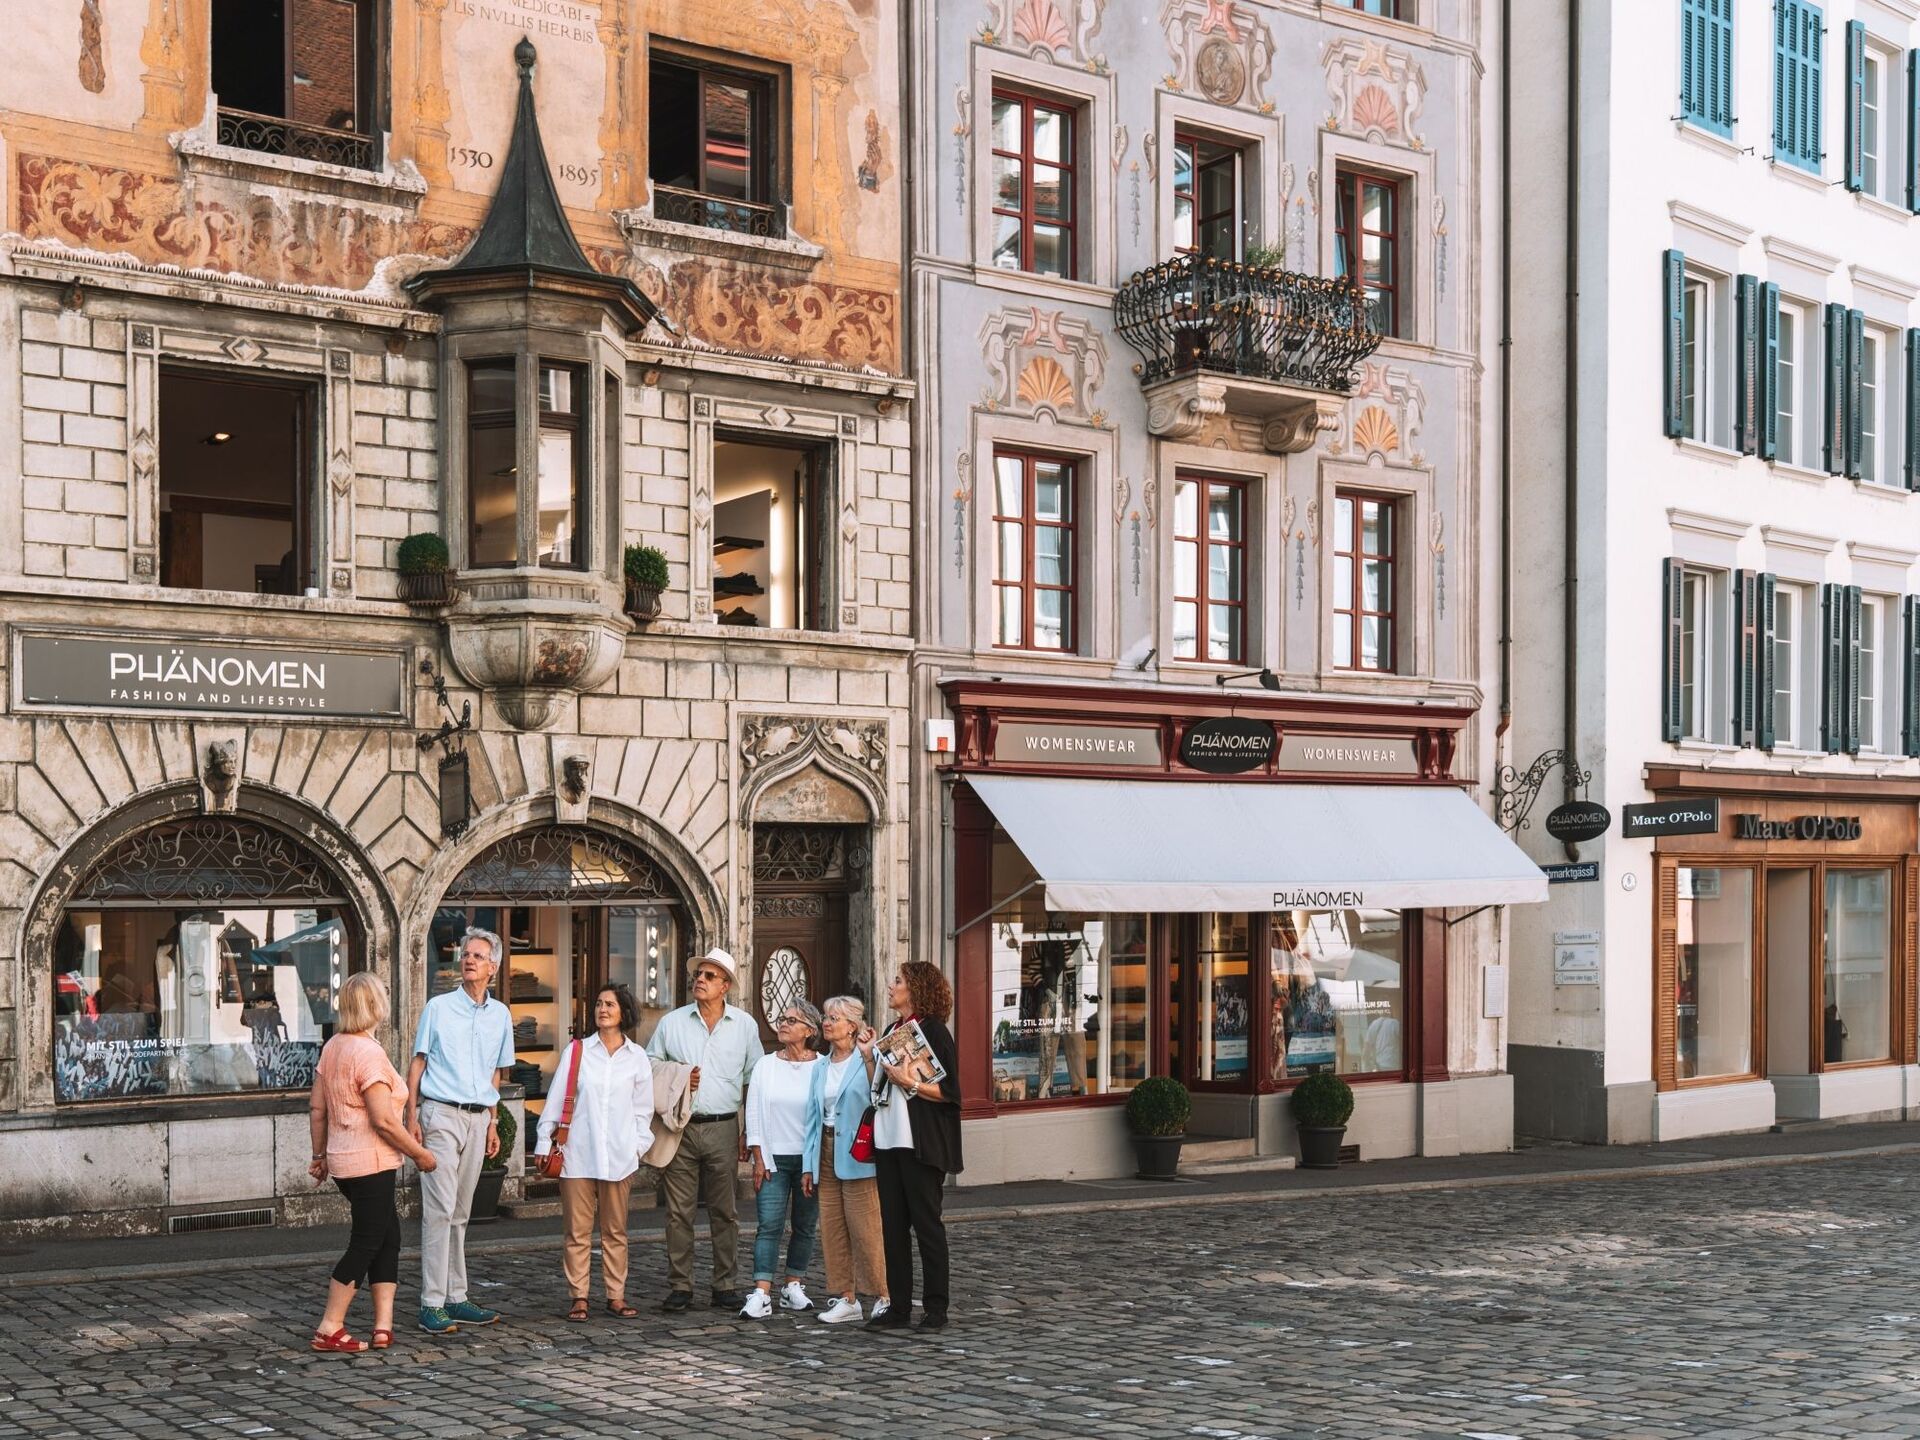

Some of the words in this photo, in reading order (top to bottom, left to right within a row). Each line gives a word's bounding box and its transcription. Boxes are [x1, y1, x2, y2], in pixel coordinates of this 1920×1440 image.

[454, 0, 475, 16] LIS
[480, 6, 534, 29] NVLLIS
[538, 19, 594, 43] HERBIS
[450, 147, 493, 169] 1530
[559, 164, 599, 187] 1895
[110, 649, 326, 690] PHÄNOMEN
[110, 689, 187, 702] FASHION
[197, 692, 231, 703] AND
[241, 694, 326, 708] LIFESTYLE
[1025, 735, 1137, 753] WOMENSWEAR
[1190, 732, 1271, 750] PHÄNOMEN
[1303, 747, 1397, 762] WOMENSWEAR
[1550, 812, 1606, 825] PHÄNOMEN
[1631, 814, 1666, 826] Marc
[1669, 811, 1712, 824] O'Polo
[1802, 815, 1863, 840] O'Polo
[1273, 889, 1363, 907] PHÄNOMEN
[1023, 1019, 1037, 1027] STIL
[1038, 1018, 1054, 1026] ZUM
[86, 1041, 107, 1051] MIT
[108, 1040, 131, 1050] STIL
[133, 1039, 157, 1049] ZUM
[160, 1037, 188, 1048] SPIEL
